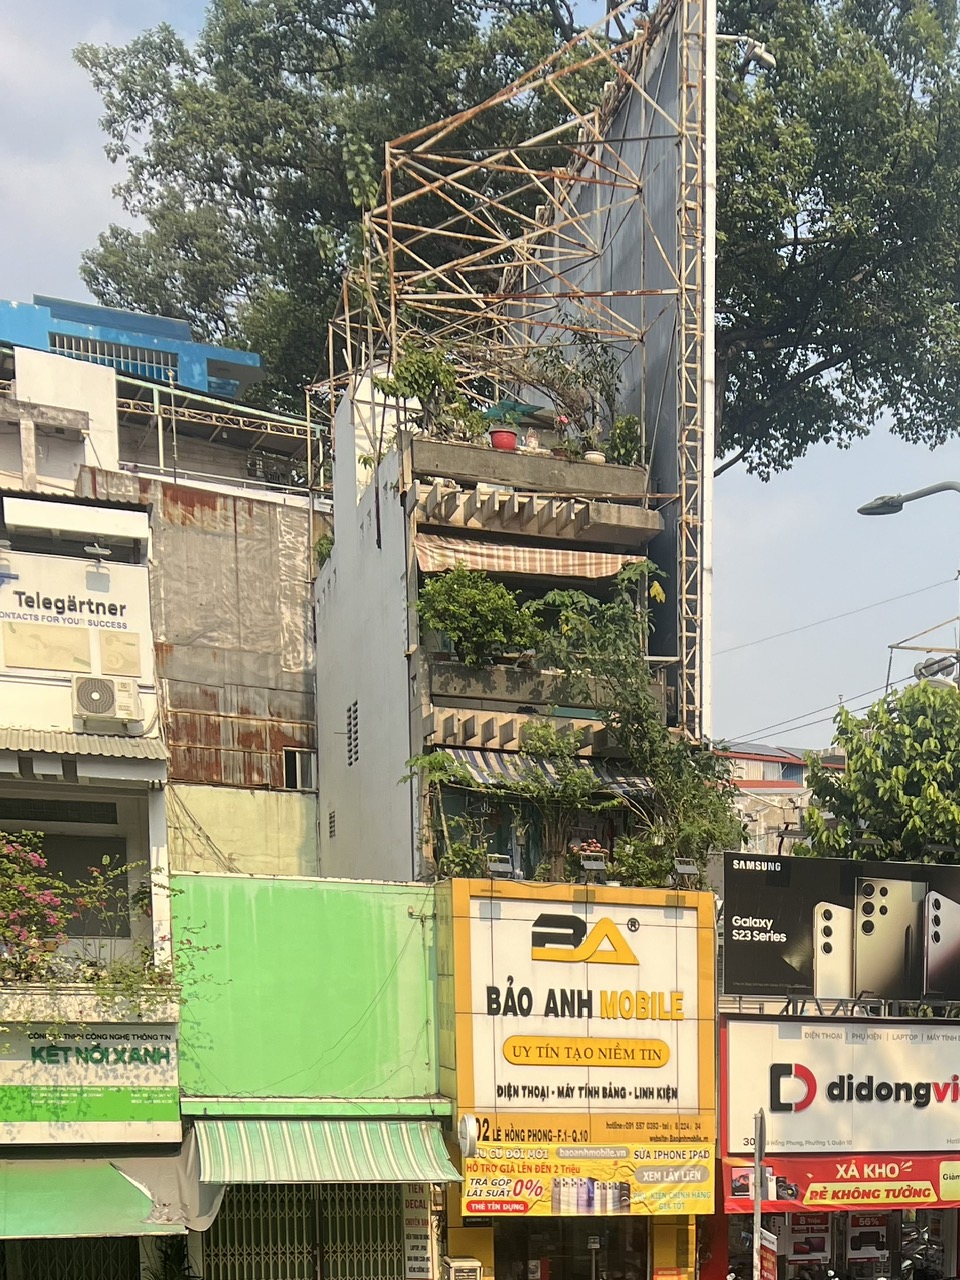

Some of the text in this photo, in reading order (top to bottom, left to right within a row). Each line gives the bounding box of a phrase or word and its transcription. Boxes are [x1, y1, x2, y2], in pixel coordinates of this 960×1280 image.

[12, 590, 127, 617] Telegärtner
[41, 614, 60, 623] FOR
[88, 619, 127, 629] SUCCESS
[733, 860, 781, 871] SAMSUNG
[732, 915, 773, 930] Galaxy
[732, 930, 787, 942] S23 Series
[486, 975, 684, 1021] BẢO ANH MOBILE
[28, 1032, 50, 1040] CÔN
[85, 1032, 107, 1040] CÔNG
[804, 1032, 819, 1040] ĐIỆN
[867, 1033, 882, 1041] KIỆN
[110, 1046, 170, 1065] XANH
[512, 1042, 662, 1061] UY TÍN TẠO NIỀM TIN
[497, 1082, 519, 1102] ĐIỆN
[522, 1085, 549, 1102] THOẠI
[557, 1083, 575, 1099] MÁY
[578, 1083, 599, 1099] TÍNH
[602, 1082, 626, 1099] BẢNG
[634, 1087, 654, 1100] LINH
[657, 1084, 678, 1103] KIỆN
[634, 1147, 710, 1159] SỬA IPHONE IPAD
[517, 1162, 533, 1173] LÊN
[554, 1165, 559, 1173] 2
[560, 1163, 581, 1175] Triệu
[835, 1160, 900, 1179] XẢ KHO
[490, 1176, 512, 1187] GÓP
[643, 1171, 660, 1181] XEM
[513, 1179, 543, 1197] 0%
[810, 1184, 931, 1200] RẺ KHÔNG TƯỞNG
[405, 1199, 428, 1209] DECAL
[487, 1201, 501, 1210] TÍN
[503, 1202, 524, 1211] DỤNG
[859, 1217, 879, 1226] 56%
